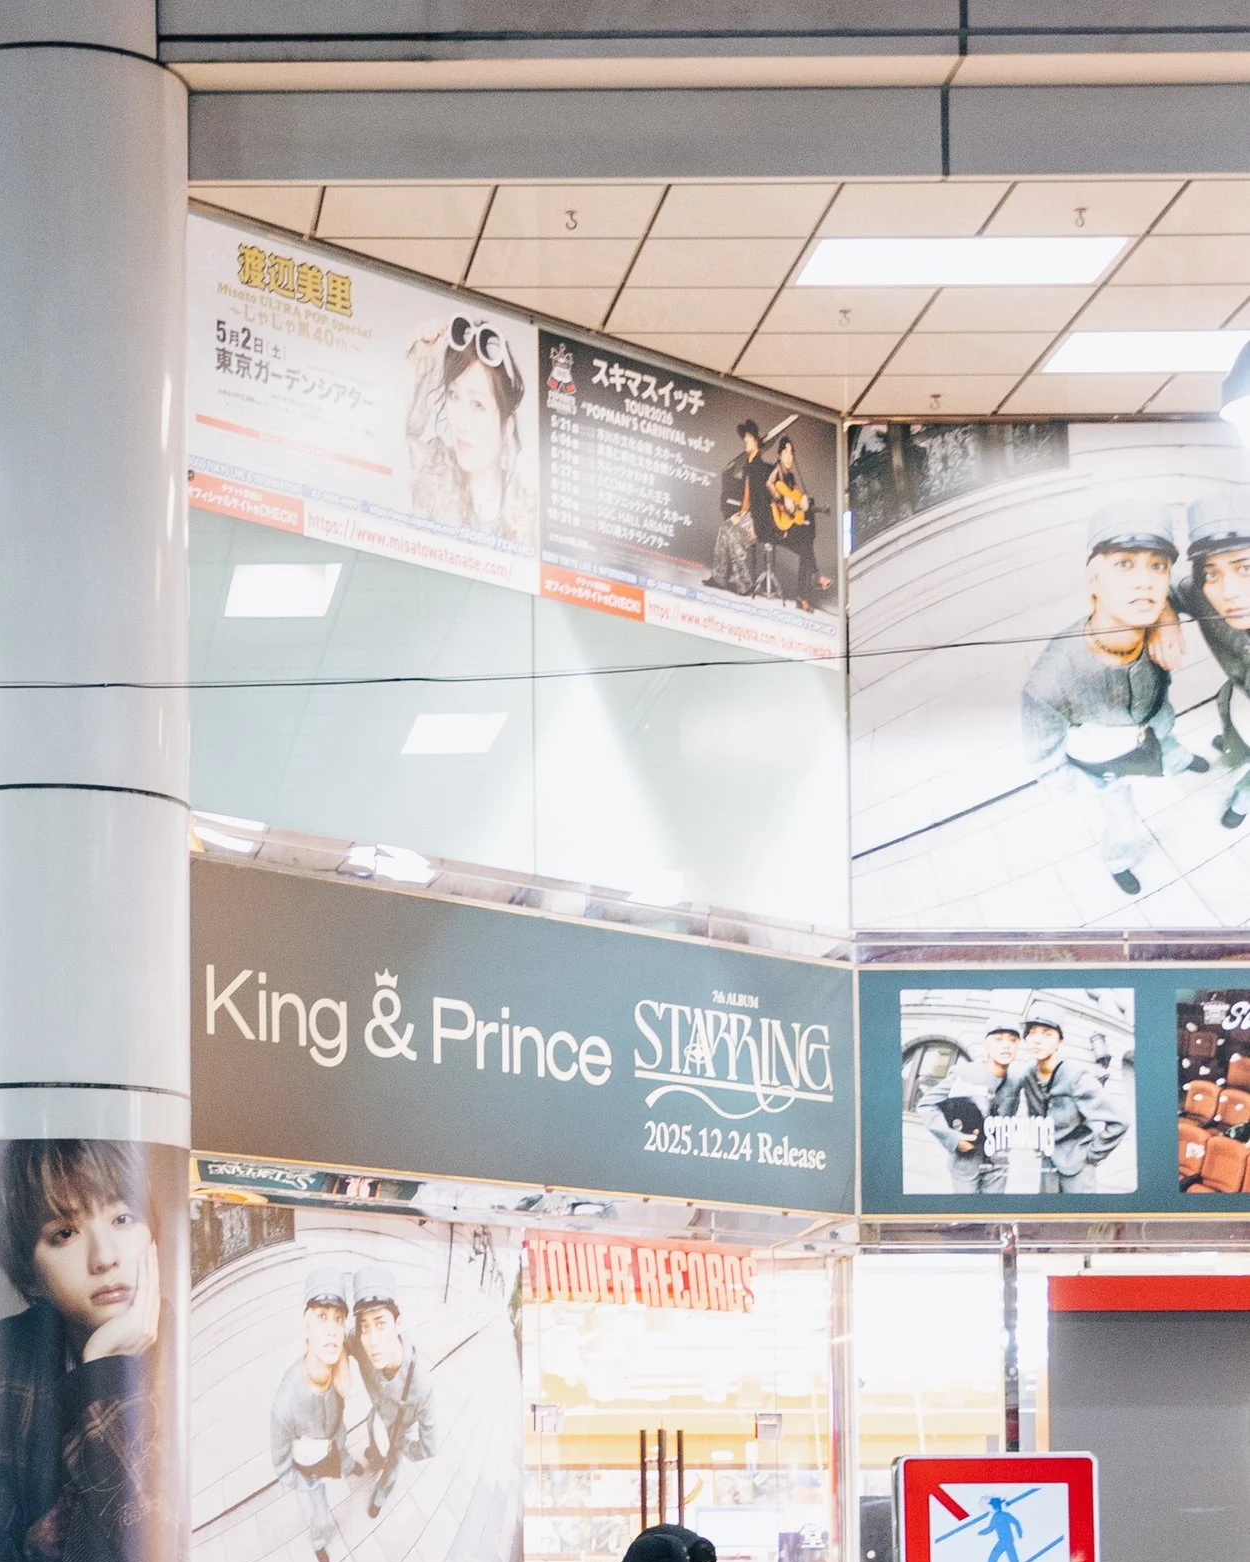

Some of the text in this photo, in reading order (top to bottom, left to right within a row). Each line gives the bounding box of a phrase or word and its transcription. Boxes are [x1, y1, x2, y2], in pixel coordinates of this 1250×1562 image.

[215, 347, 375, 408] 東京ガーデンシアター
[591, 358, 705, 416] スキマスイッチ
[206, 963, 613, 1086] King & Prince
[727, 991, 759, 1009] ALBUM
[634, 998, 834, 1095] STARRING
[643, 1120, 827, 1171] 2025.12.24 Release
[529, 1240, 758, 1314] TOWER RECORDS
